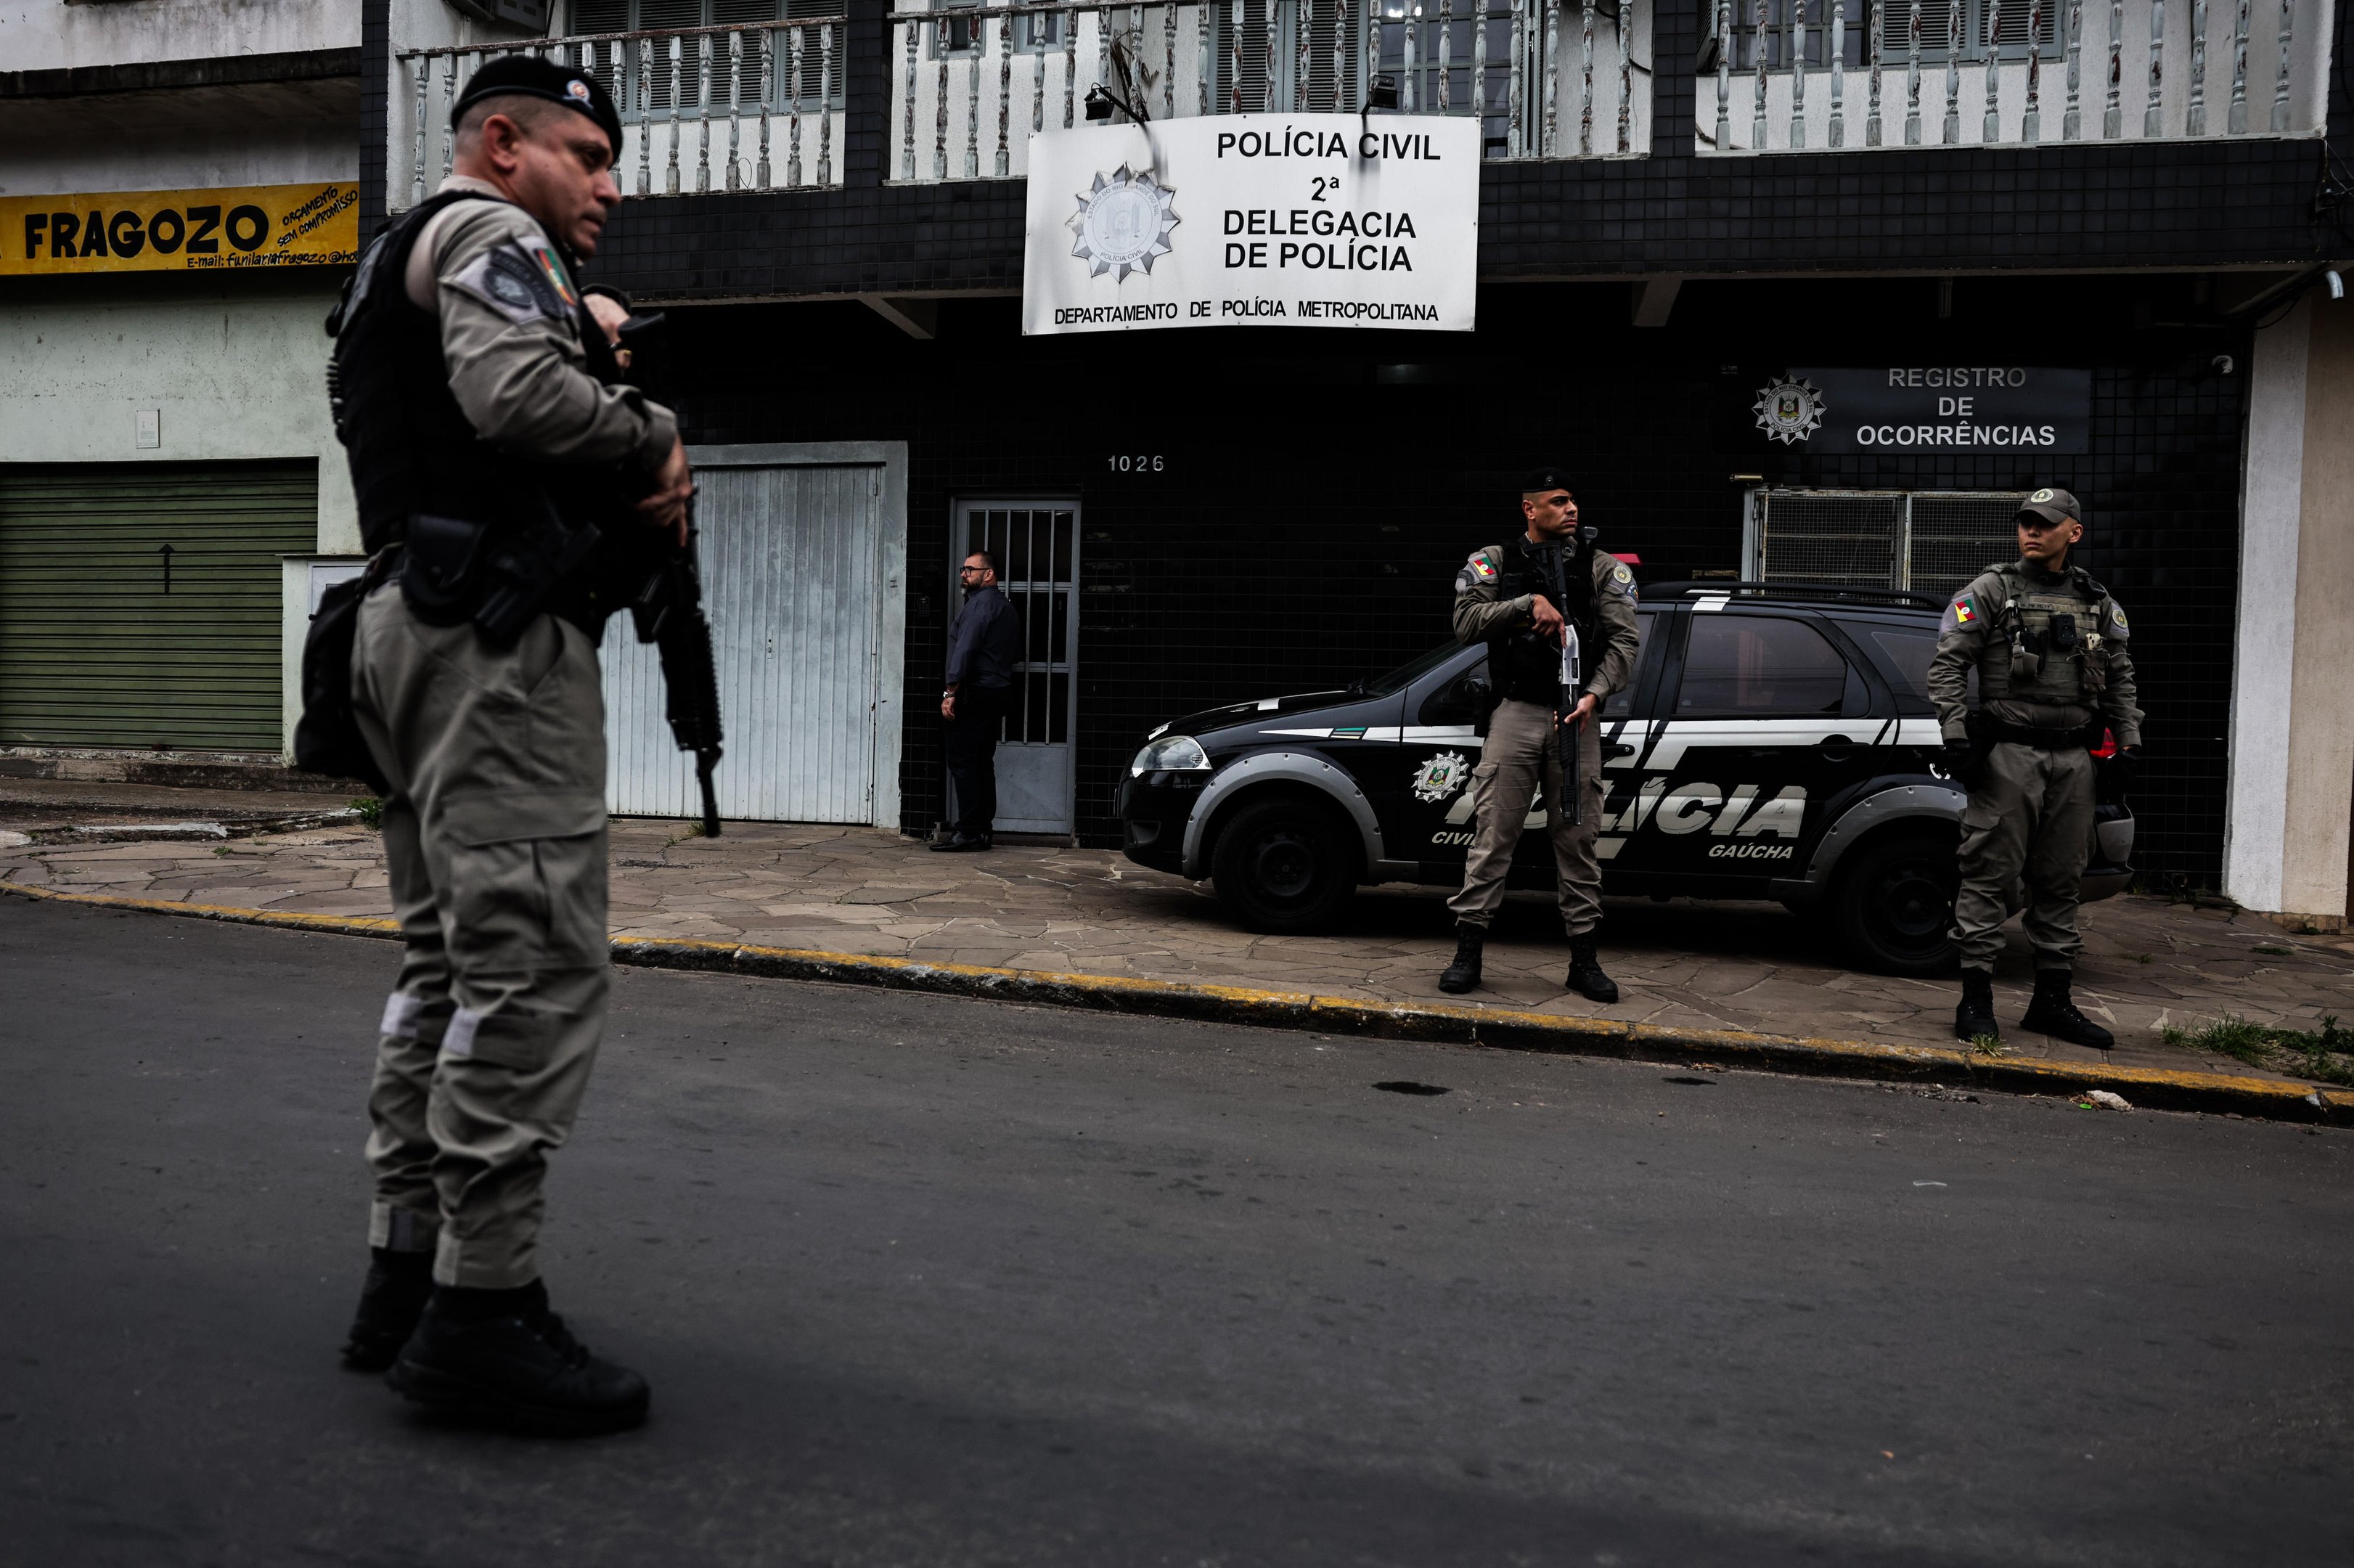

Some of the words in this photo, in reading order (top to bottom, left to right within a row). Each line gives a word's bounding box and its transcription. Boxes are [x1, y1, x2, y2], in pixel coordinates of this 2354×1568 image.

[1217, 126, 1349, 158] POLÍCIA
[1358, 132, 1442, 160] CIVIL
[282, 185, 338, 226] ORÇAMENTO
[1087, 196, 1102, 219] ESTADO
[1102, 188, 1111, 197] DO
[1148, 194, 1156, 204] DO
[24, 205, 270, 259] FRAGOZO
[1224, 209, 1417, 239] DELEGACIA
[277, 229, 298, 248] SEM
[187, 255, 225, 269] E-mail:
[1100, 251, 1127, 262] POLÍCIA
[1127, 249, 1145, 260] CIVIL
[1225, 242, 1267, 269] DE
[1279, 238, 1413, 272] POLÍCIA
[1055, 302, 1178, 324] DEPARTAMENTO
[1190, 301, 1211, 318] DE
[1222, 295, 1287, 317] POLÍCIA
[1298, 301, 1439, 322] METROPOLITANA
[1888, 367, 2026, 388] REGISTRO
[1789, 385, 1807, 396] GRANDE
[1938, 397, 1974, 417] DE
[1792, 423, 1807, 432] CIVIL
[1856, 420, 2056, 446] OCORRÊNCIAS
[1108, 456, 1164, 472] 1026
[1707, 842, 1794, 859] GAÚCHA
